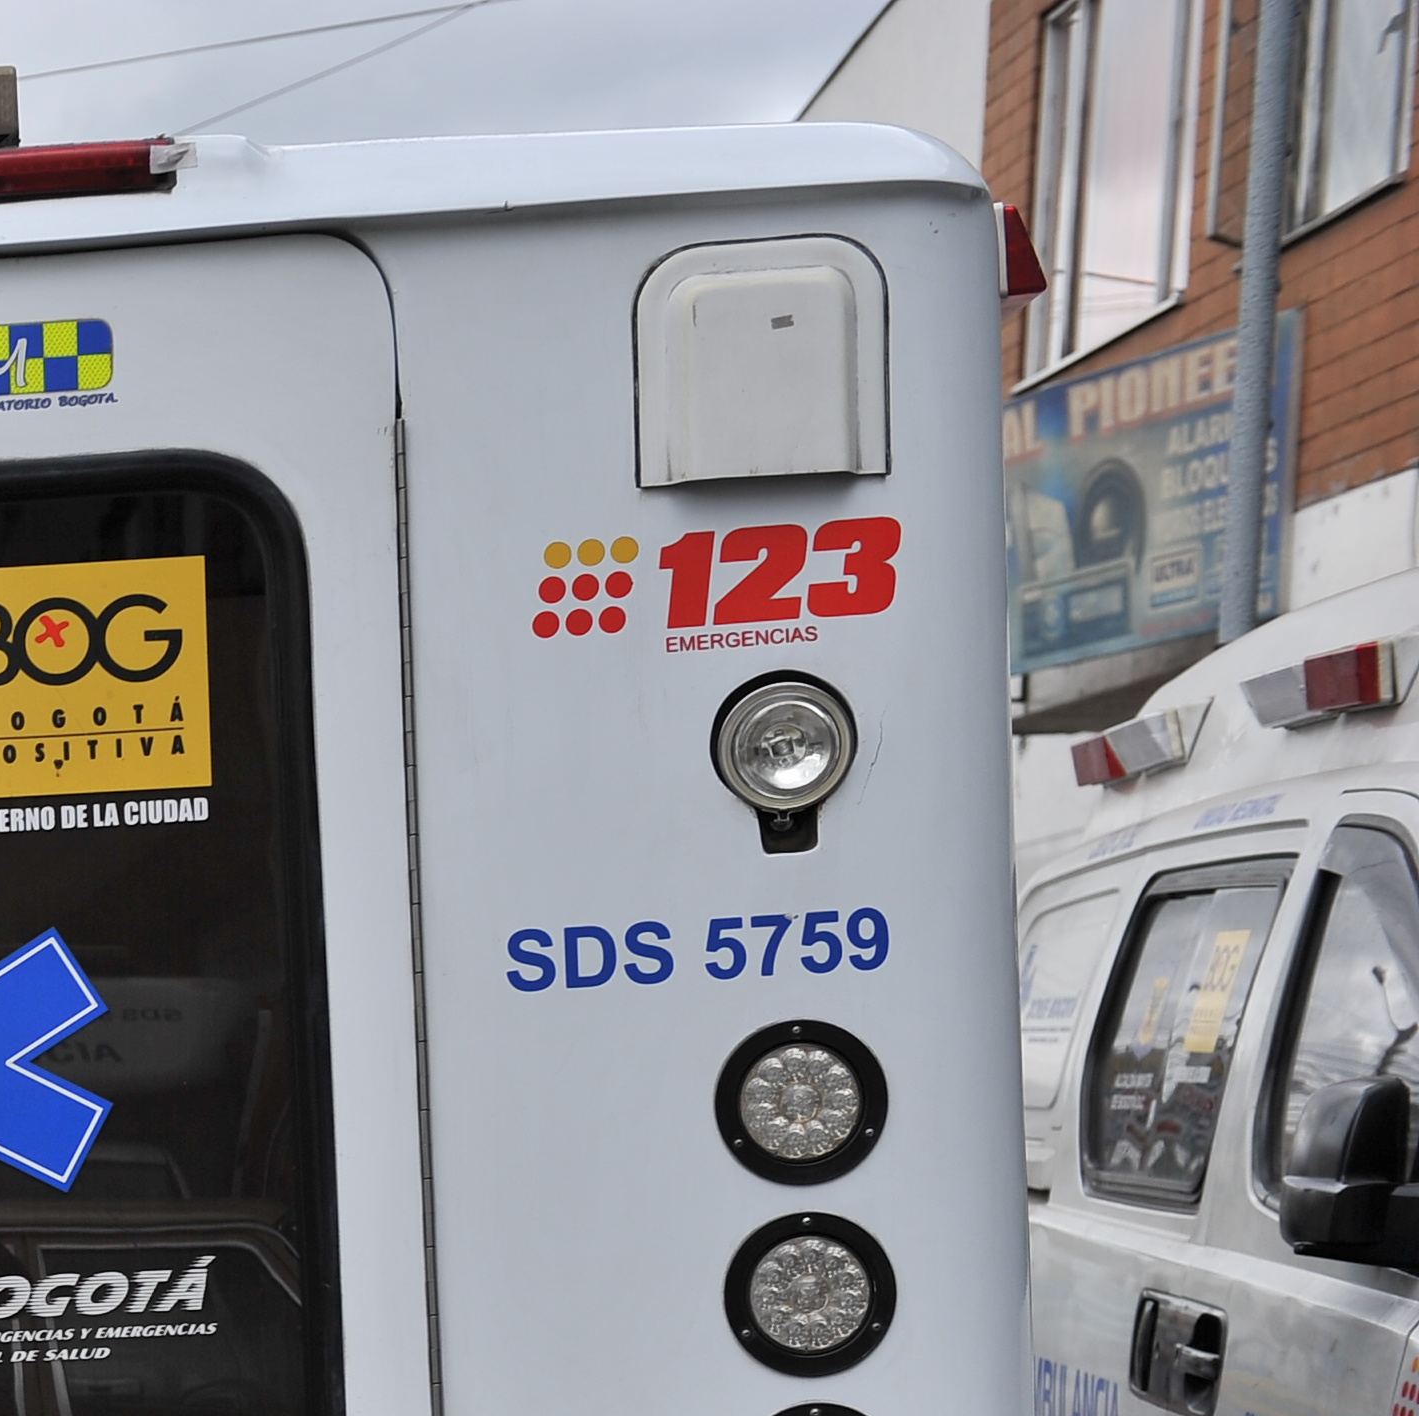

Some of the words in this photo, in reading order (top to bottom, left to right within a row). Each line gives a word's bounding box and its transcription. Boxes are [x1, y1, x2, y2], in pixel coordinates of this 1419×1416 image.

[658, 516, 902, 629] 123
[665, 625, 819, 654] EMERGENCIAS
[59, 803, 90, 829] DE
[92, 802, 120, 827] LA
[123, 796, 210, 827] CIUDAD
[505, 920, 675, 992] SDS
[704, 906, 890, 981] 5759
[80, 1327, 94, 1340] Y
[94, 1322, 219, 1340] EMERGENCIAS
[10, 1349, 40, 1364] DE
[42, 1346, 112, 1363] SALUD
